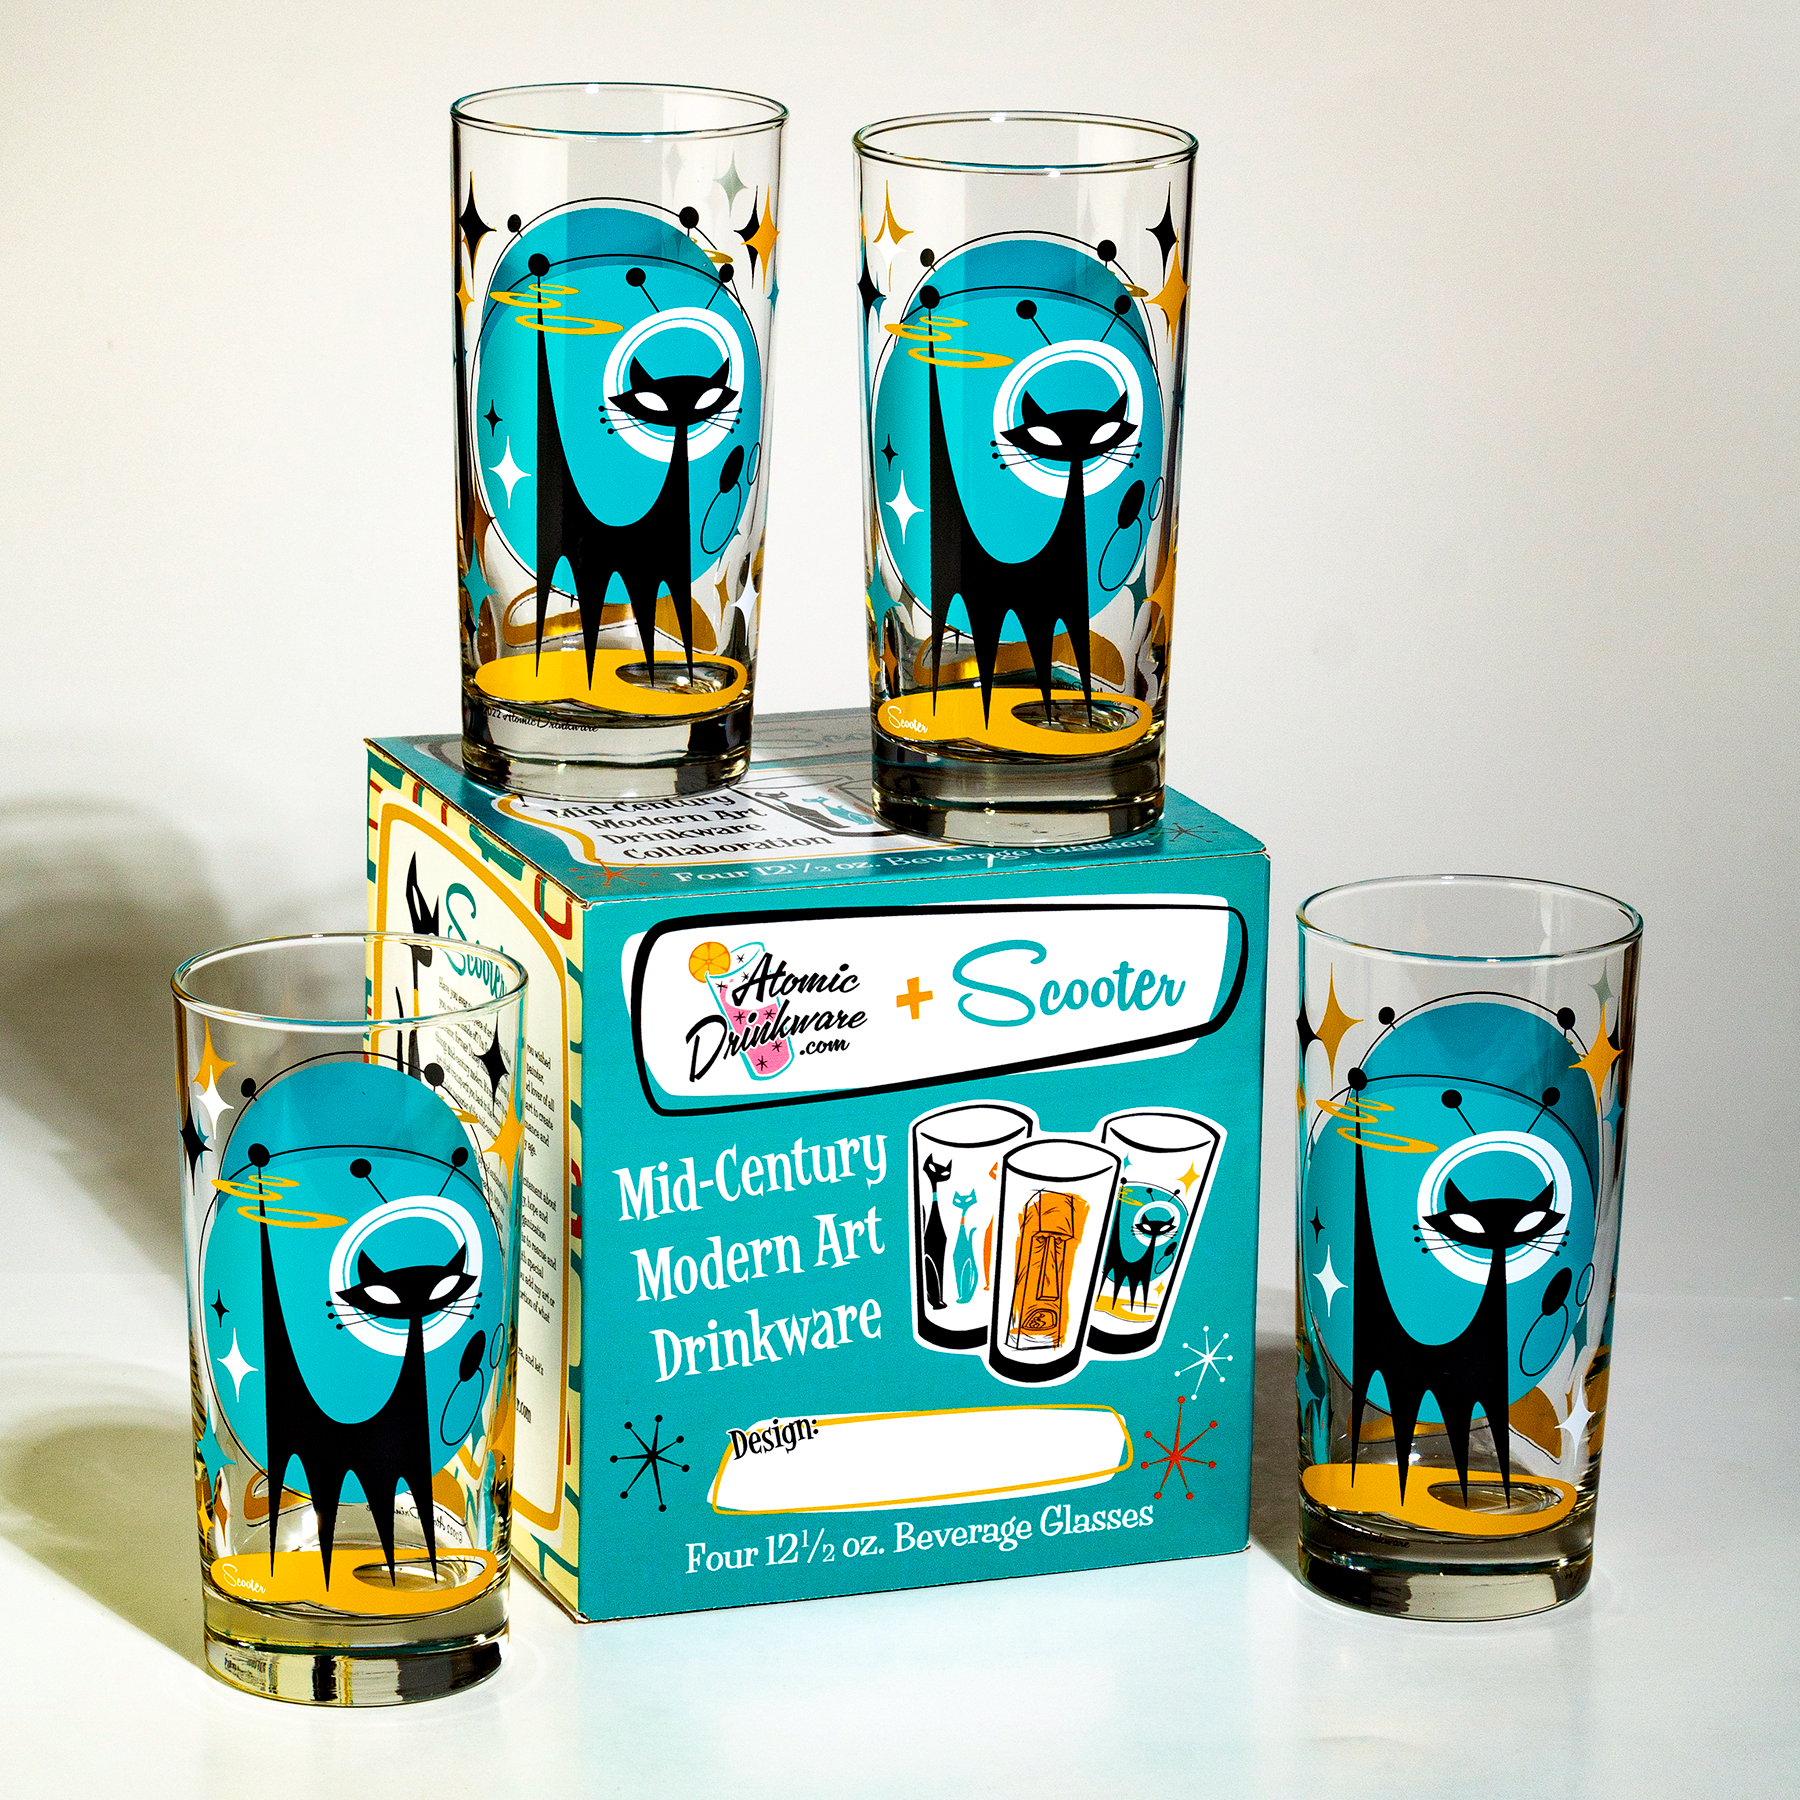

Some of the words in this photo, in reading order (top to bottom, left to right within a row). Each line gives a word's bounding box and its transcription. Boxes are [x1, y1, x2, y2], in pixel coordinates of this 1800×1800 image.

[886, 704, 928, 734] Scooter
[544, 792, 736, 819] Mid-Century
[587, 810, 708, 831] Modern
[710, 806, 767, 822] Art
[600, 822, 766, 845] Drinkware
[622, 834, 833, 860] Collaboration
[671, 868, 749, 884] Four
[835, 858, 880, 872] oz.
[884, 847, 1021, 868] Beverage
[732, 952, 861, 1007] Atomic
[952, 939, 1186, 1027] Scooter
[685, 998, 868, 1083] Drinkware
[799, 1037, 850, 1057] .com
[612, 1134, 888, 1222] Mid-Century
[629, 1235, 806, 1302] Modern
[812, 1205, 886, 1269] Art
[649, 1299, 883, 1383] Drinkware
[728, 1416, 820, 1461] Design:
[684, 1541, 760, 1575] Four
[842, 1534, 886, 1559] oz.
[894, 1517, 1033, 1552] Beverage
[1039, 1504, 1155, 1538] Glasses
[221, 1563, 266, 1595] Scooter
